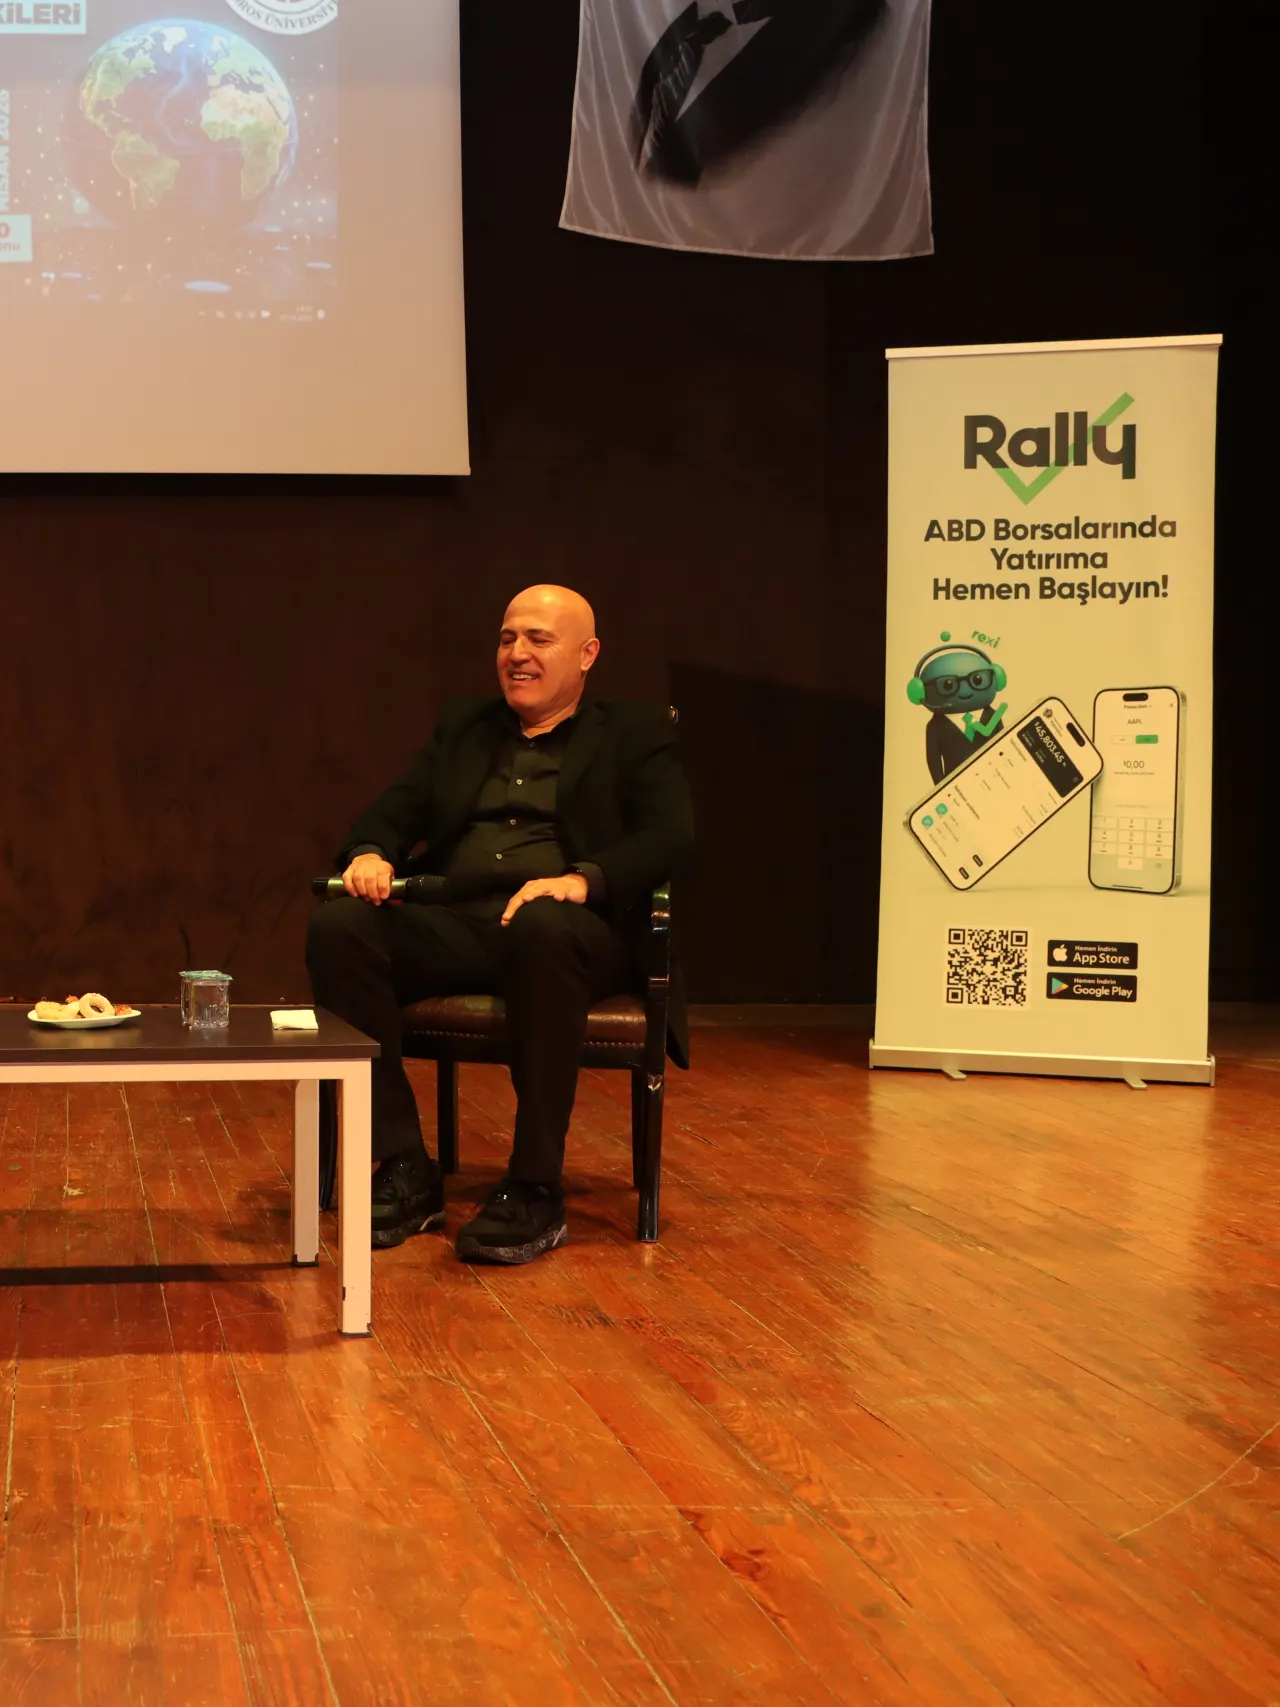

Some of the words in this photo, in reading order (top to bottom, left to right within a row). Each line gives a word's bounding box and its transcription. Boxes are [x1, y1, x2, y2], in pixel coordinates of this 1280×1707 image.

[963, 411, 1137, 480] Rally
[923, 519, 986, 543] ABD
[993, 514, 1177, 542] Borsalarında
[990, 547, 1109, 571] Yatırıma
[932, 577, 1031, 601] Hemen
[1038, 574, 1169, 606] Başlayın!
[971, 629, 1001, 649] rexi
[1073, 952, 1098, 965] App
[1099, 953, 1130, 965] Store
[1073, 985, 1110, 997] Google
[1111, 986, 1133, 999] Play
